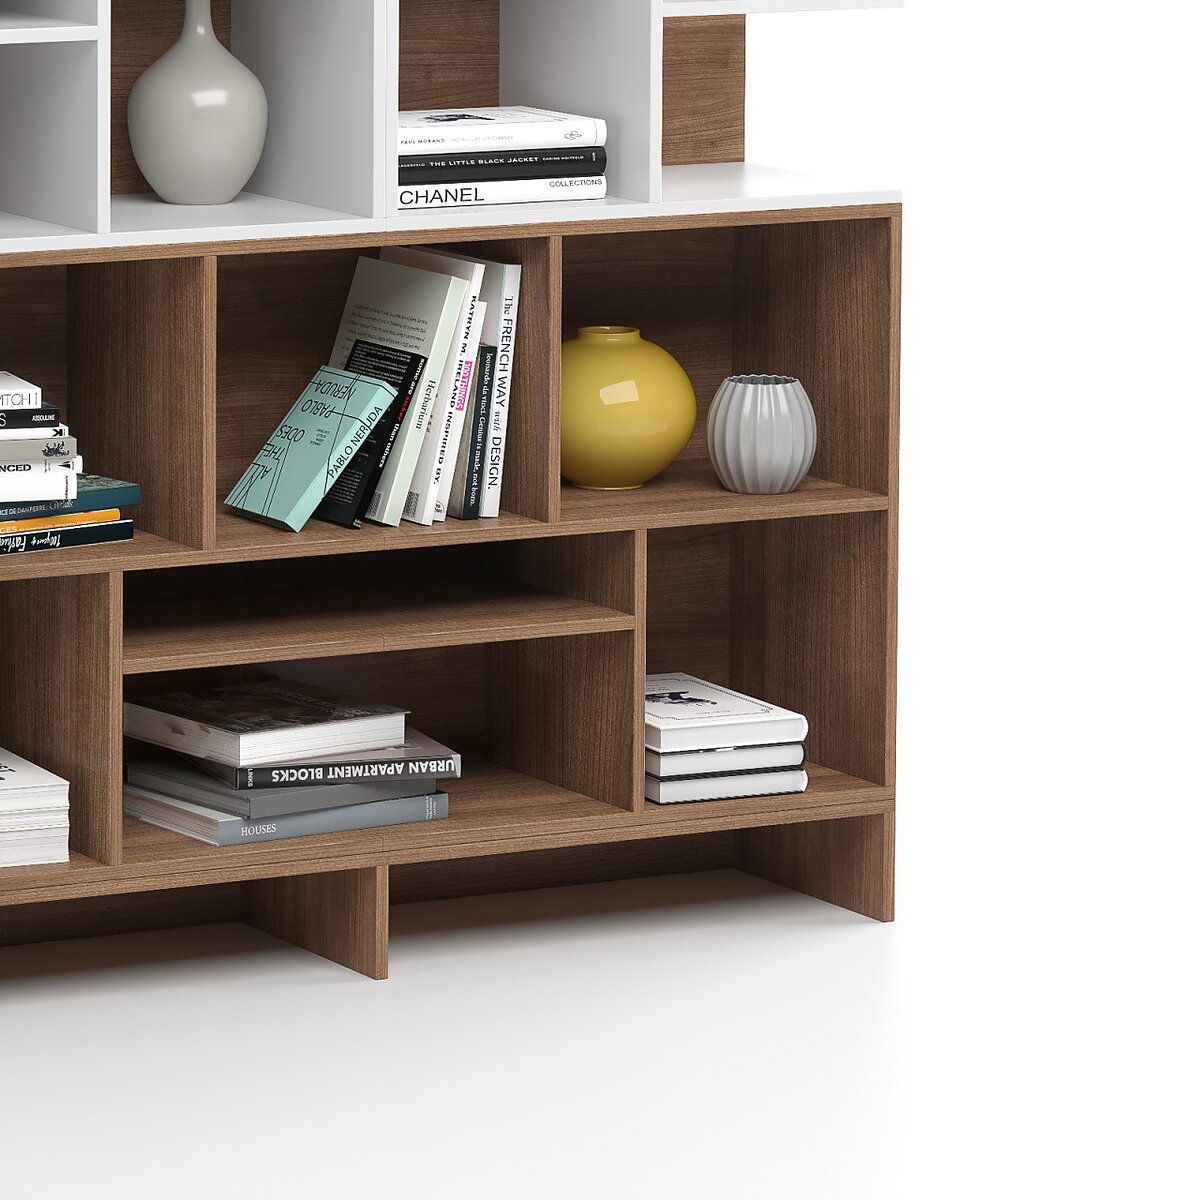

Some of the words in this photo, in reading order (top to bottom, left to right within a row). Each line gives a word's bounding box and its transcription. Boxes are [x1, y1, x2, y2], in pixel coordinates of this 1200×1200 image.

[549, 179, 603, 188] COLLECTIONS
[400, 187, 485, 205] CHANEL
[503, 296, 514, 315] The
[464, 295, 477, 340] KATRYN
[459, 342, 467, 356] M.
[499, 318, 513, 372] FRENCH
[413, 358, 425, 381] some
[315, 380, 356, 400] NERUDA
[407, 382, 416, 395] are
[449, 360, 464, 409] IRELAND
[456, 375, 470, 410] THINGS
[496, 376, 508, 408] WAY
[301, 399, 336, 419] PABLO
[415, 380, 436, 430] Herbarium
[476, 416, 486, 442] Genius
[493, 411, 501, 432] with
[276, 424, 306, 443] ODES
[327, 445, 354, 479] PABLO
[350, 405, 383, 447] NERUDA
[389, 423, 400, 441] than
[438, 411, 453, 465] INSPIRED
[261, 442, 286, 461] THE
[378, 443, 392, 468] others
[488, 436, 502, 490] DESIGN.
[471, 474, 479, 486] not
[271, 768, 324, 783] BLOCKS
[327, 762, 404, 779] APARTMENT
[409, 759, 455, 774] URBAN
[241, 823, 277, 836] HOUSES
